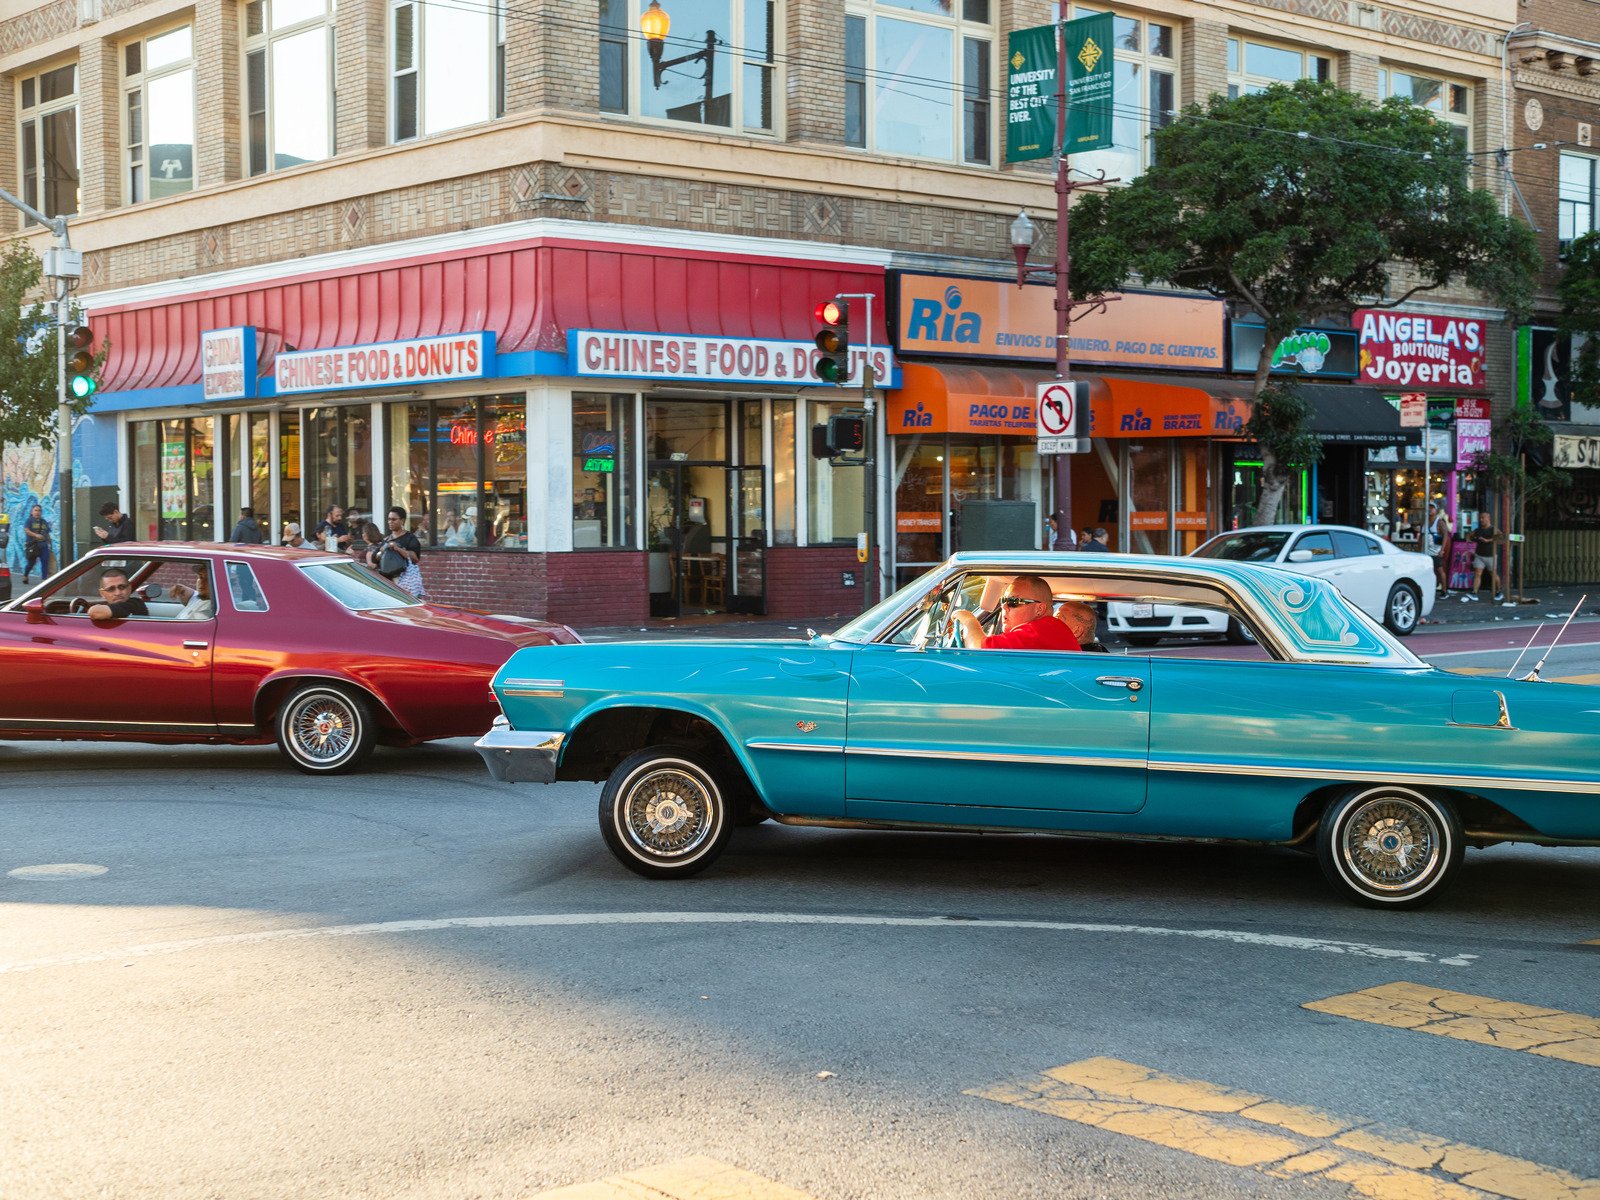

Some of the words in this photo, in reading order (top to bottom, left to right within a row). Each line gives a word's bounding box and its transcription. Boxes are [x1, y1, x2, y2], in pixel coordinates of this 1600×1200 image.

[1010, 69, 1055, 84] UNIVERSITY
[1010, 86, 1020, 97] OF
[1022, 84, 1037, 95] THE
[1010, 98, 1029, 110] BEST
[1030, 95, 1048, 108] CITY
[1009, 111, 1031, 123] EVER.
[907, 285, 982, 343] Ria
[995, 332, 1042, 348] ENVIOS
[1115, 341, 1147, 355] PAGO
[1149, 343, 1165, 356] DE
[1167, 345, 1219, 359] CUENTAS.
[1360, 313, 1480, 353] ANGELA'S
[205, 335, 243, 368] CHINA
[278, 353, 343, 389] CHINESE
[347, 348, 391, 383] FOOD
[393, 352, 404, 379] &
[406, 339, 478, 377] DONUTS
[585, 336, 698, 373] CHINESE
[705, 340, 769, 377] FOOD
[774, 350, 788, 377] &
[793, 346, 887, 383] DOUTS
[1392, 342, 1450, 362] BOUTIQUE
[205, 370, 244, 396] EXPRESS
[1366, 358, 1474, 386] Joyeria
[902, 402, 933, 427] Ria
[969, 404, 1009, 419] PAGO
[1012, 406, 1030, 420] DE
[1120, 408, 1152, 431] Ria
[1214, 405, 1244, 430] Ria
[1163, 420, 1202, 430] BRAZIL
[1578, 438, 1600, 466] ST
[583, 458, 615, 472] ATM
